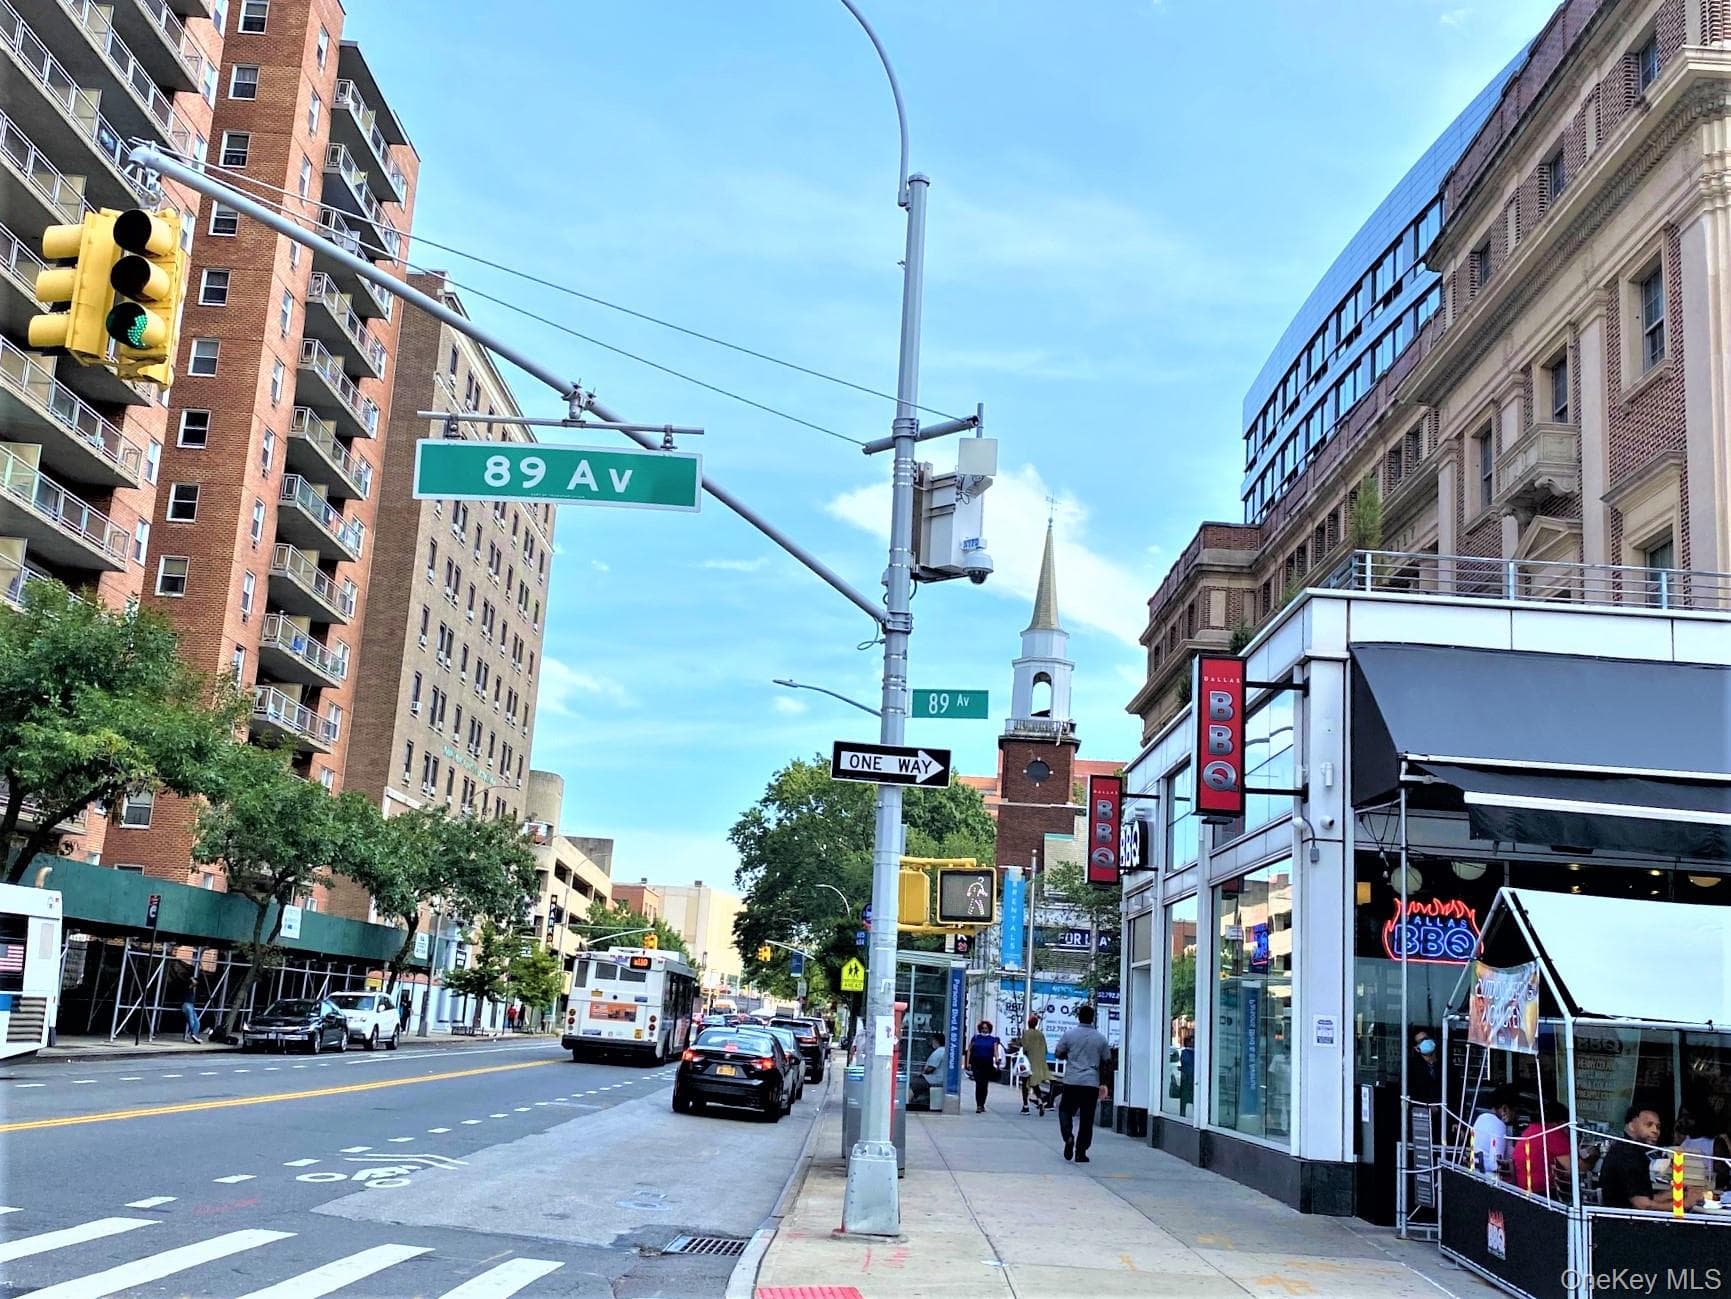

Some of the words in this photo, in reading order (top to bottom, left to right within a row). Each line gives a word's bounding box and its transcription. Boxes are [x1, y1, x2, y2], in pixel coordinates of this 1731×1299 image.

[483, 455, 547, 489] 89
[566, 459, 633, 494] Av
[1203, 676, 1241, 684] DALLAS
[928, 692, 950, 715] 89
[956, 693, 970, 707] Av
[1203, 690, 1238, 793] BBQ
[849, 754, 883, 771] ONE
[898, 757, 933, 774] WAY
[1091, 799, 1116, 868] BBQ
[1119, 820, 1140, 868] BBQ
[1405, 916, 1468, 929] ALLAS
[1394, 924, 1477, 959] BBQ
[951, 1008, 959, 1025] Blvd
